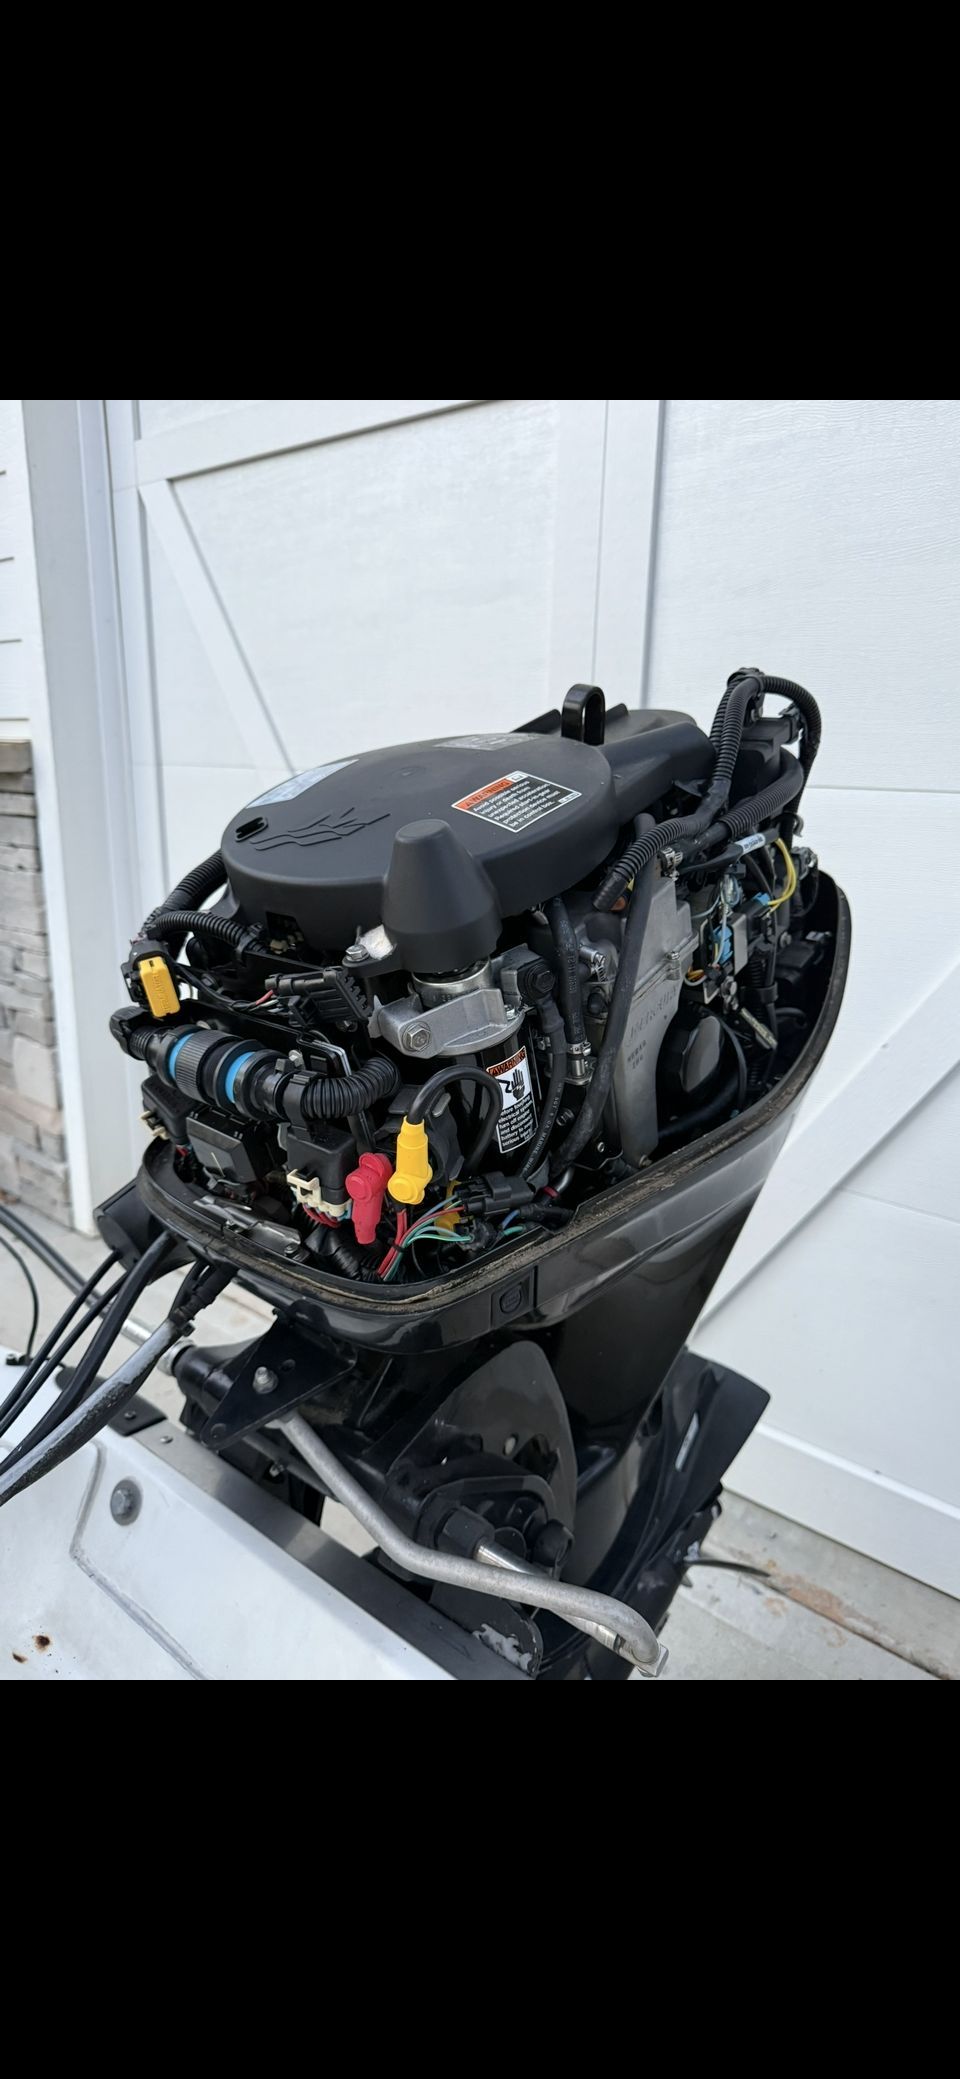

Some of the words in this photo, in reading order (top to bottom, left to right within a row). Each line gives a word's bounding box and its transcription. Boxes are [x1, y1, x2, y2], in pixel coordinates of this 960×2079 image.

[473, 801, 489, 811] Avoid
[489, 790, 511, 803] possible
[511, 781, 530, 791] serious
[481, 804, 497, 814] injury
[503, 792, 518, 802] death
[489, 798, 519, 817] unexpected
[494, 805, 520, 820] Required
[503, 806, 530, 824] protection
[529, 797, 547, 808] device
[546, 790, 560, 799] must
[524, 807, 542, 819] control
[513, 1095, 530, 1109] touching
[498, 1109, 520, 1123] electrical
[510, 1113, 532, 1131] disconnect
[501, 1131, 518, 1140] battery
[502, 1137, 520, 1146] serious
